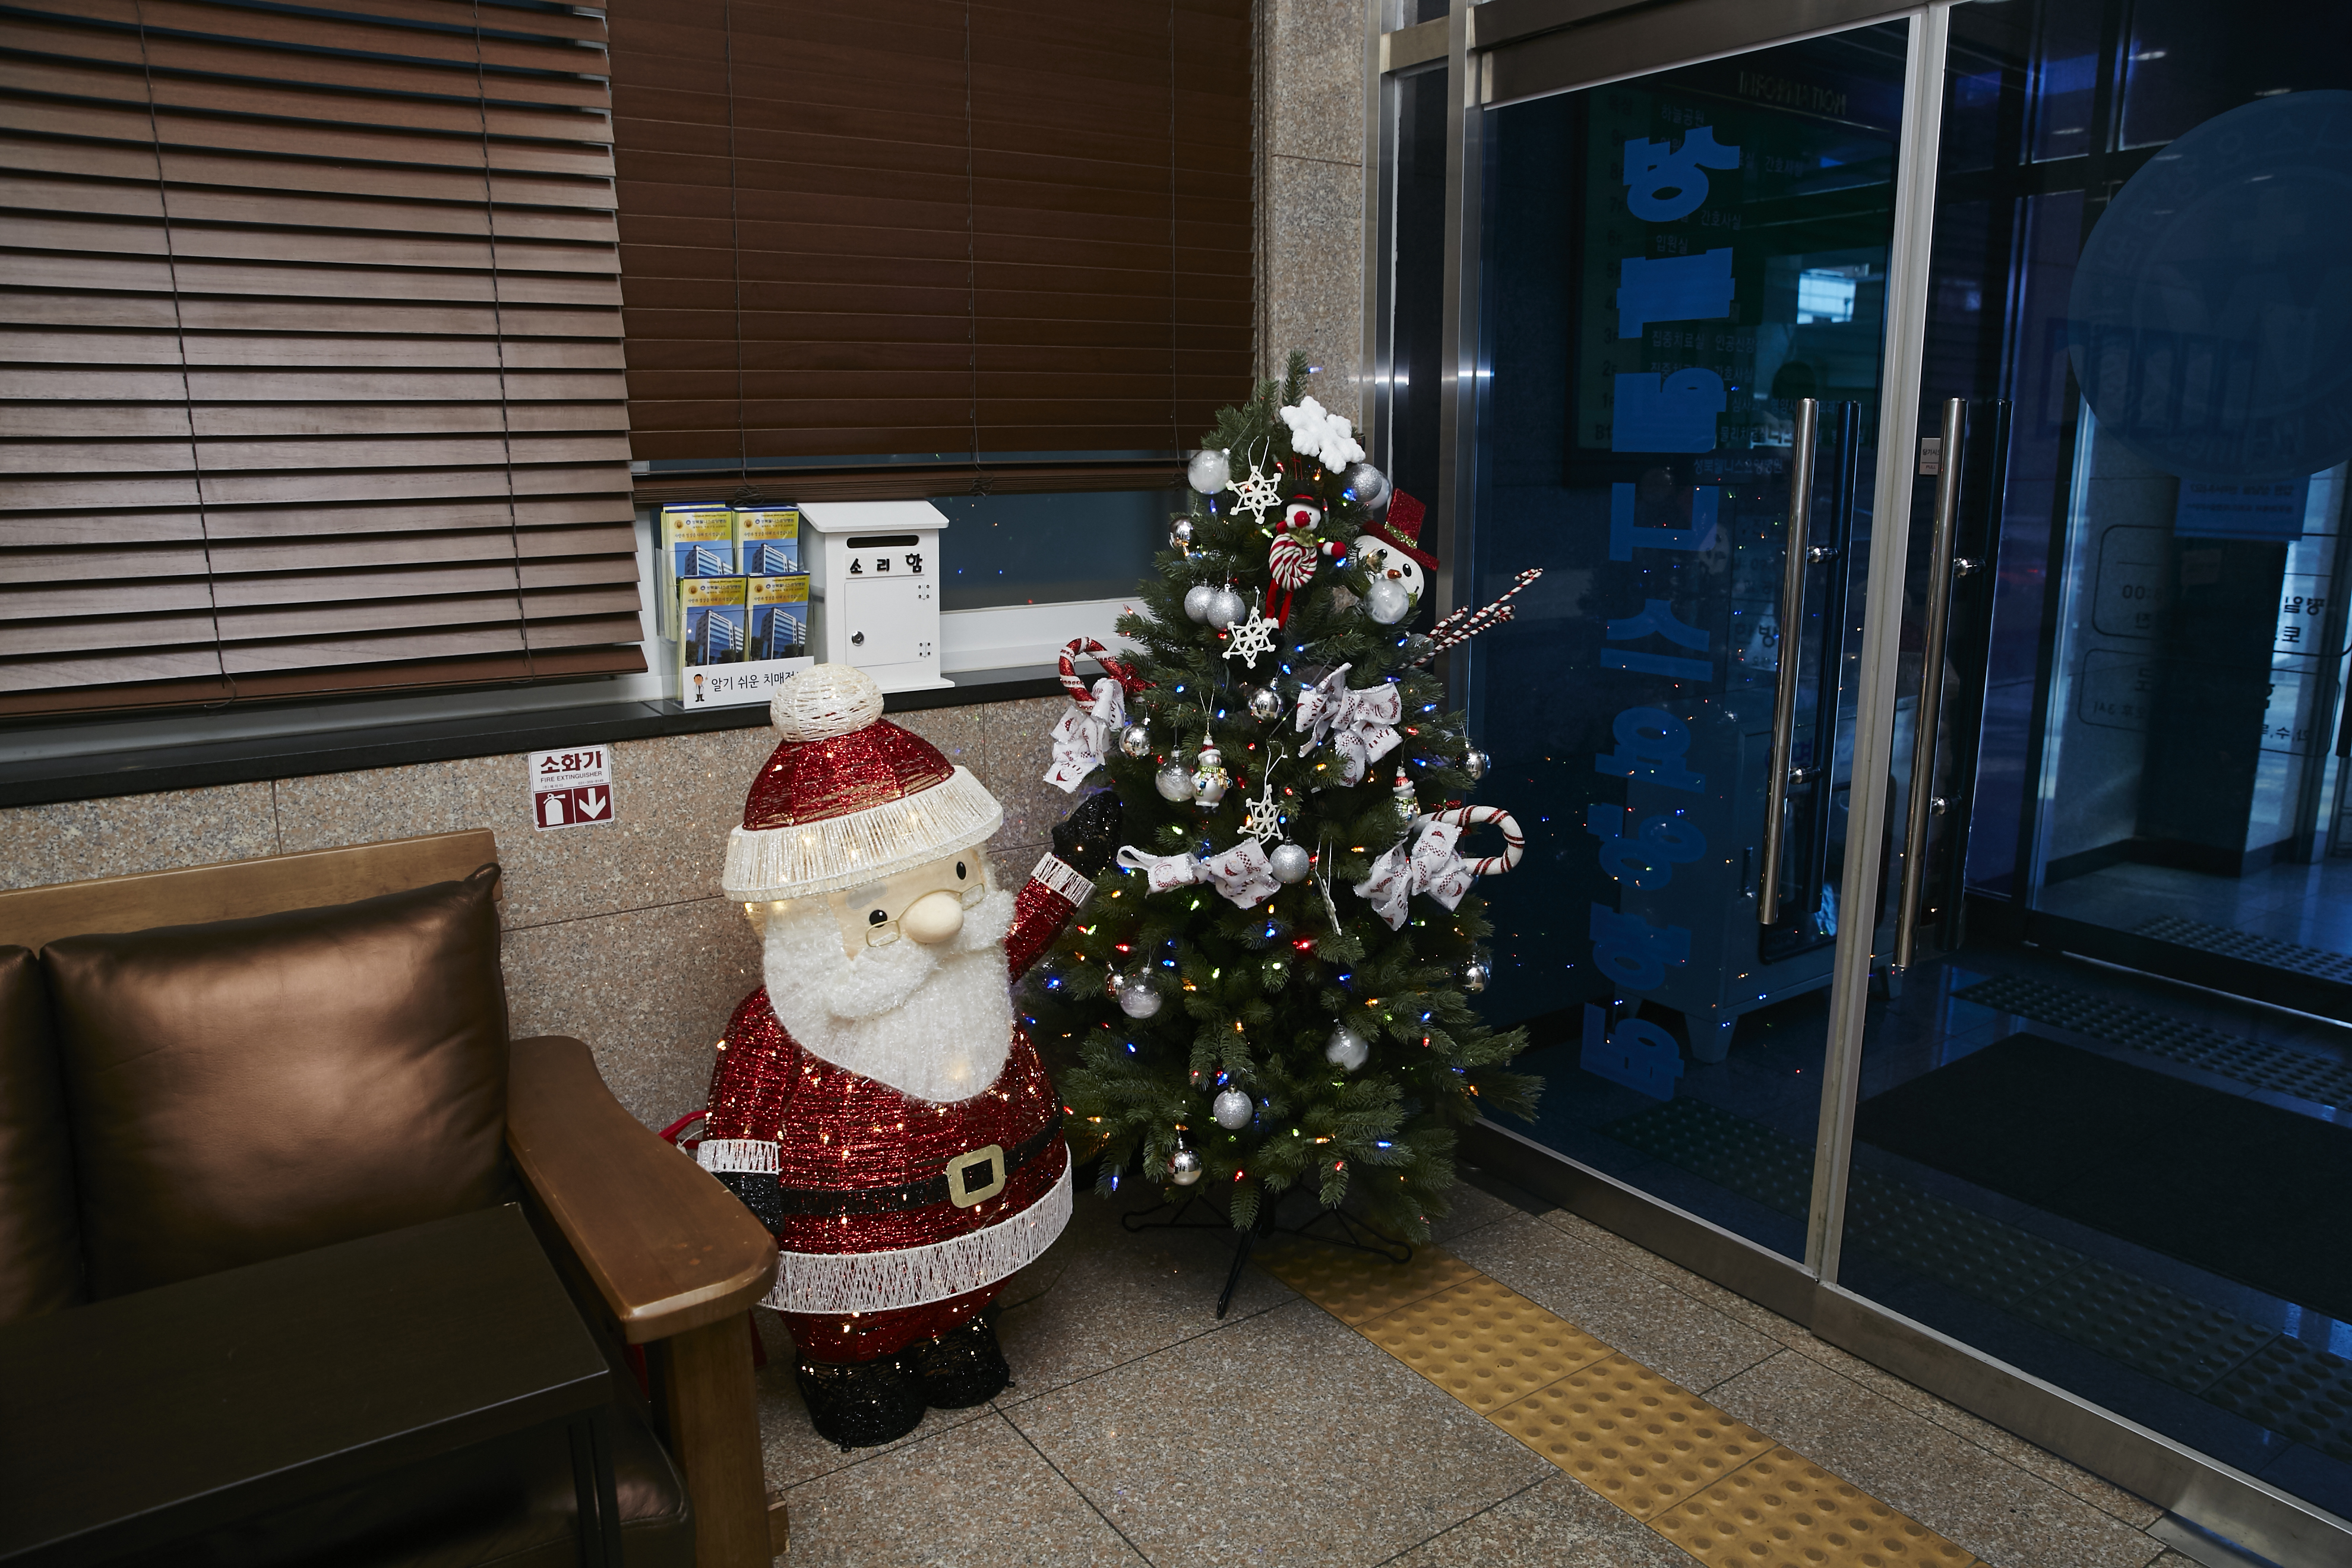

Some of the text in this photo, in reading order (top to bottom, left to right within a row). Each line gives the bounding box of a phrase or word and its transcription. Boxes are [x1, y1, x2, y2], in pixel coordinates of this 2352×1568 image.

[1661, 104, 1705, 128] 하늘공원
[1701, 210, 1741, 230] 간호사실
[1656, 235, 1688, 255] 입원실
[1652, 330, 1705, 349] 집중치료실
[711, 671, 799, 691] 알기 쉬운 치매
[540, 751, 602, 774] 소화기
[557, 771, 602, 781] EXTINGUISHER
